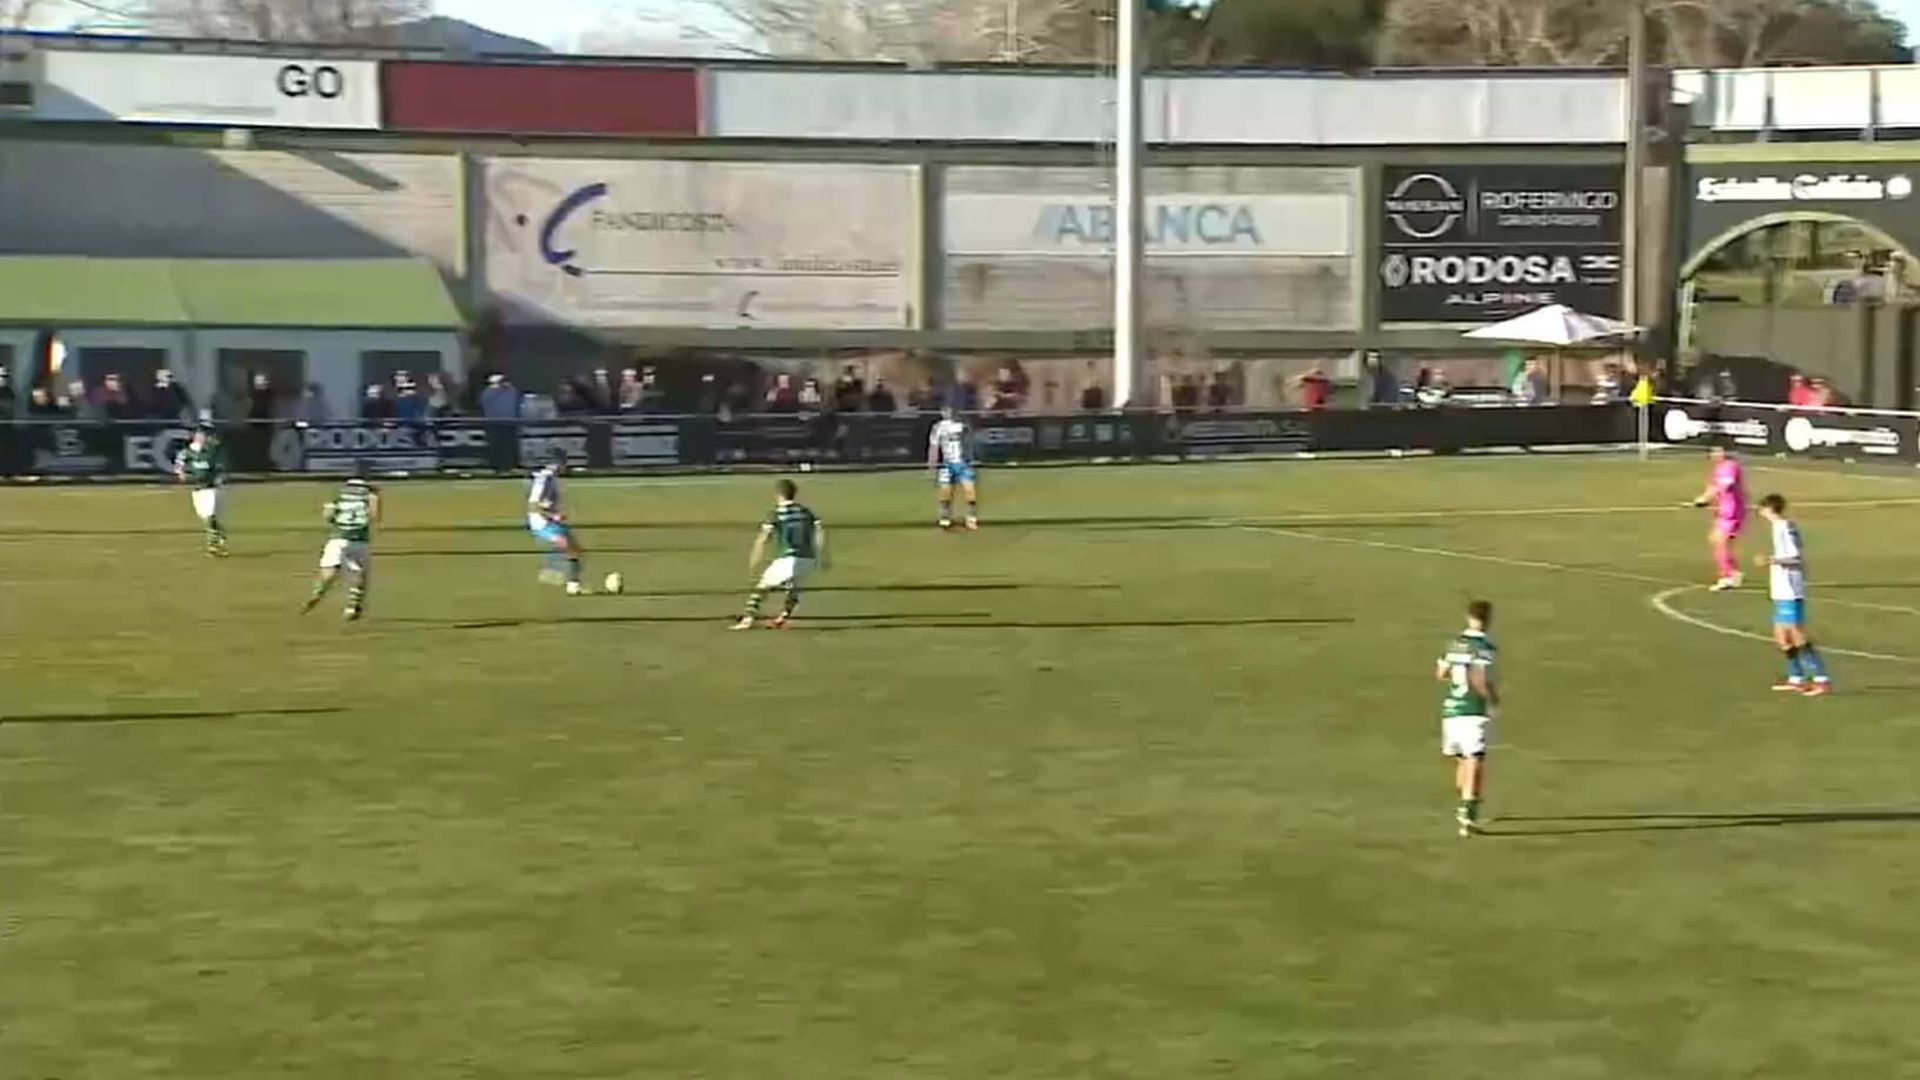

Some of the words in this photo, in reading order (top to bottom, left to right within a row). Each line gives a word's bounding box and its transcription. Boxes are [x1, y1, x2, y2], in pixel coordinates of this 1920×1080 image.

[277, 64, 343, 99] GO
[1054, 205, 1264, 244] ABNCA
[1410, 256, 1577, 284] RODOSA
